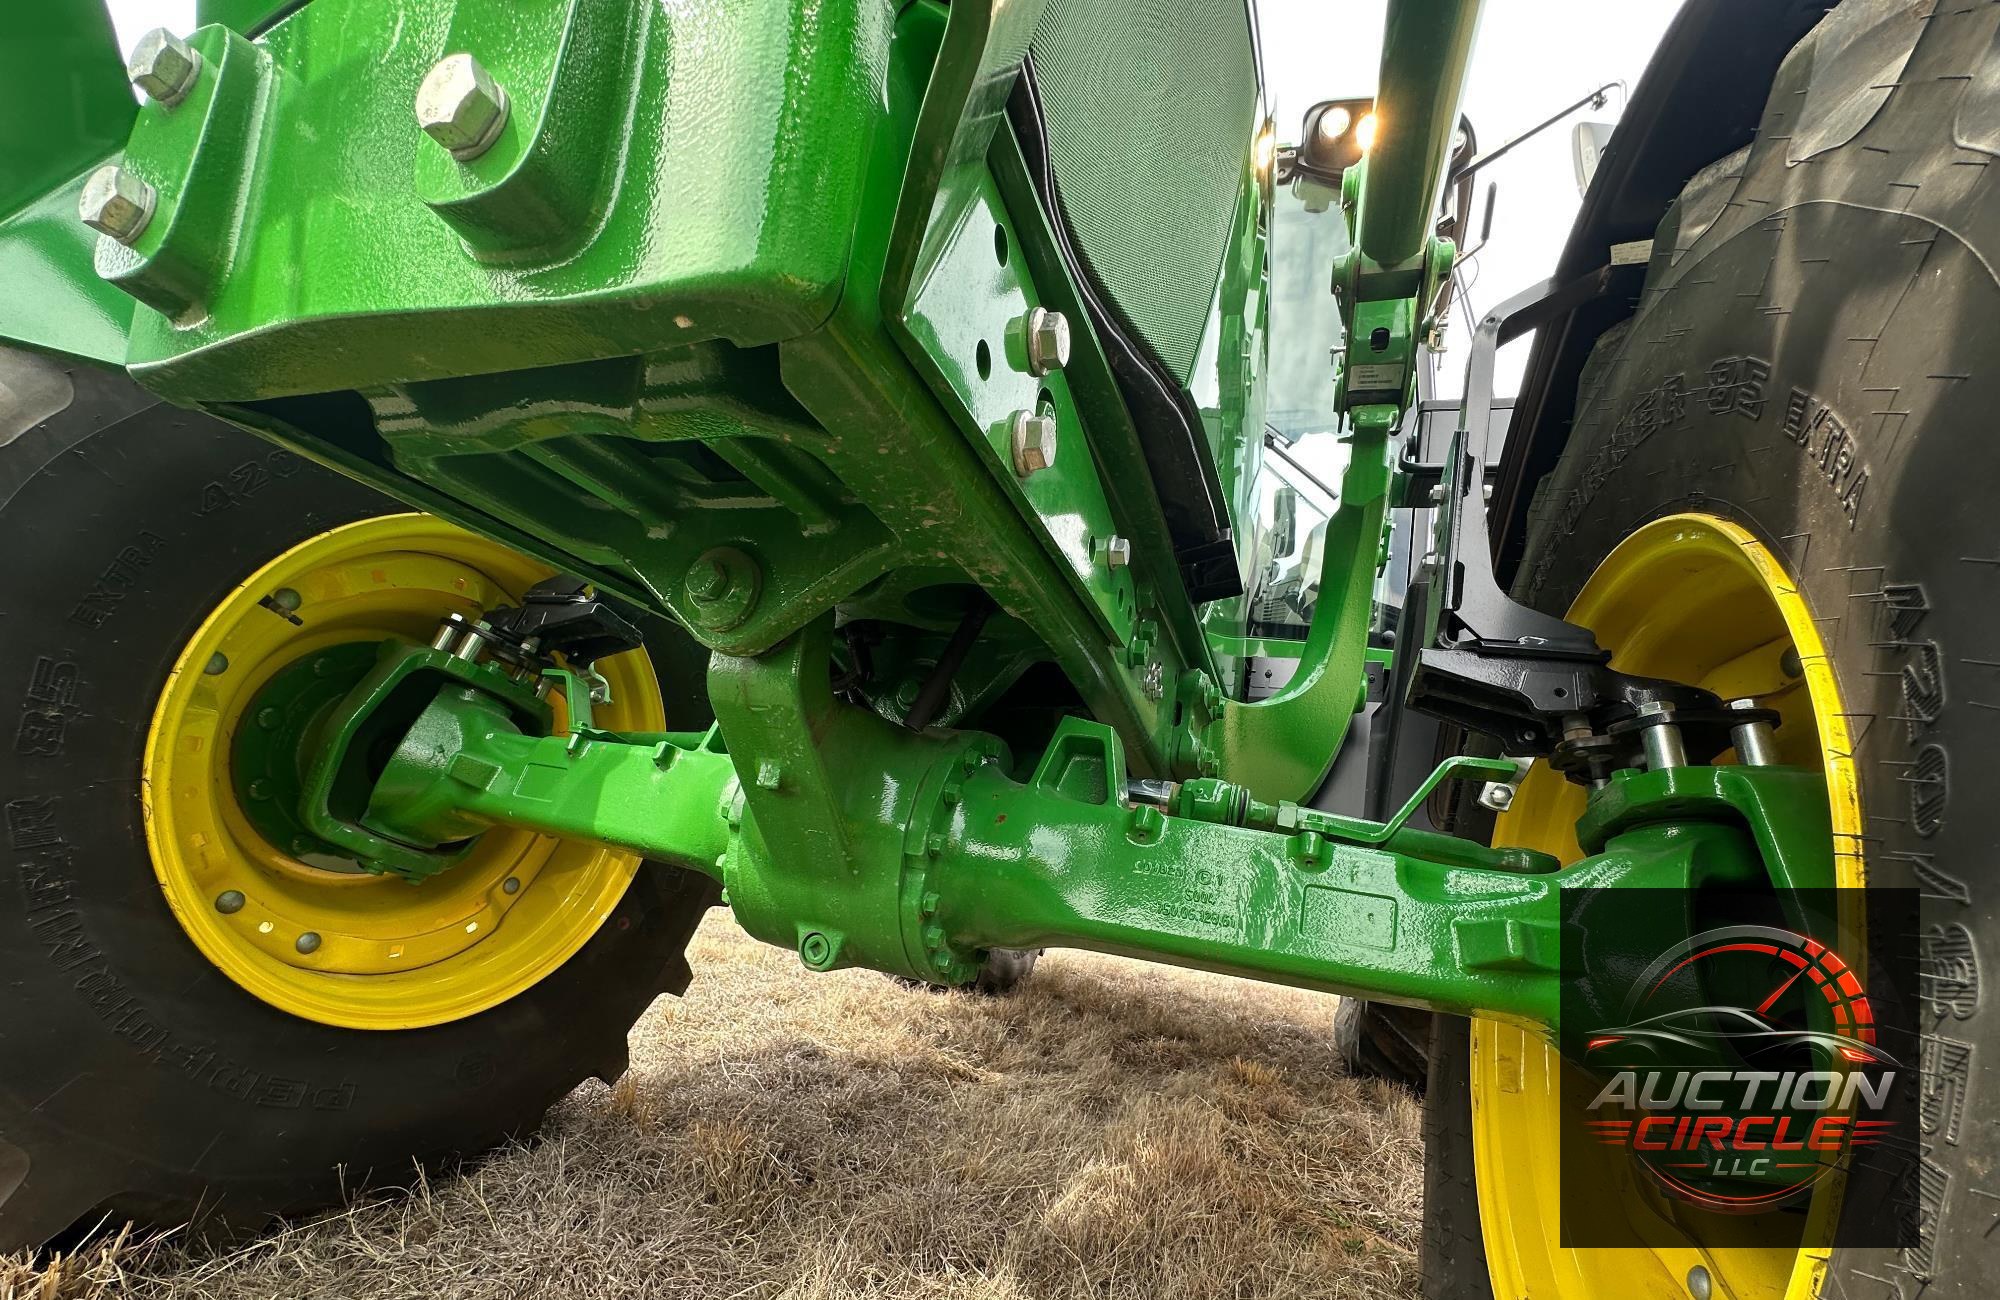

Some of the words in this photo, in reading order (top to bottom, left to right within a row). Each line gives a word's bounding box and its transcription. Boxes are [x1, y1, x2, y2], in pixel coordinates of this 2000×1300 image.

[1703, 354, 1770, 421] 85
[1783, 385, 1871, 532] EXTRA
[12, 655, 80, 756] 85
[67, 526, 169, 632] EXTRA
